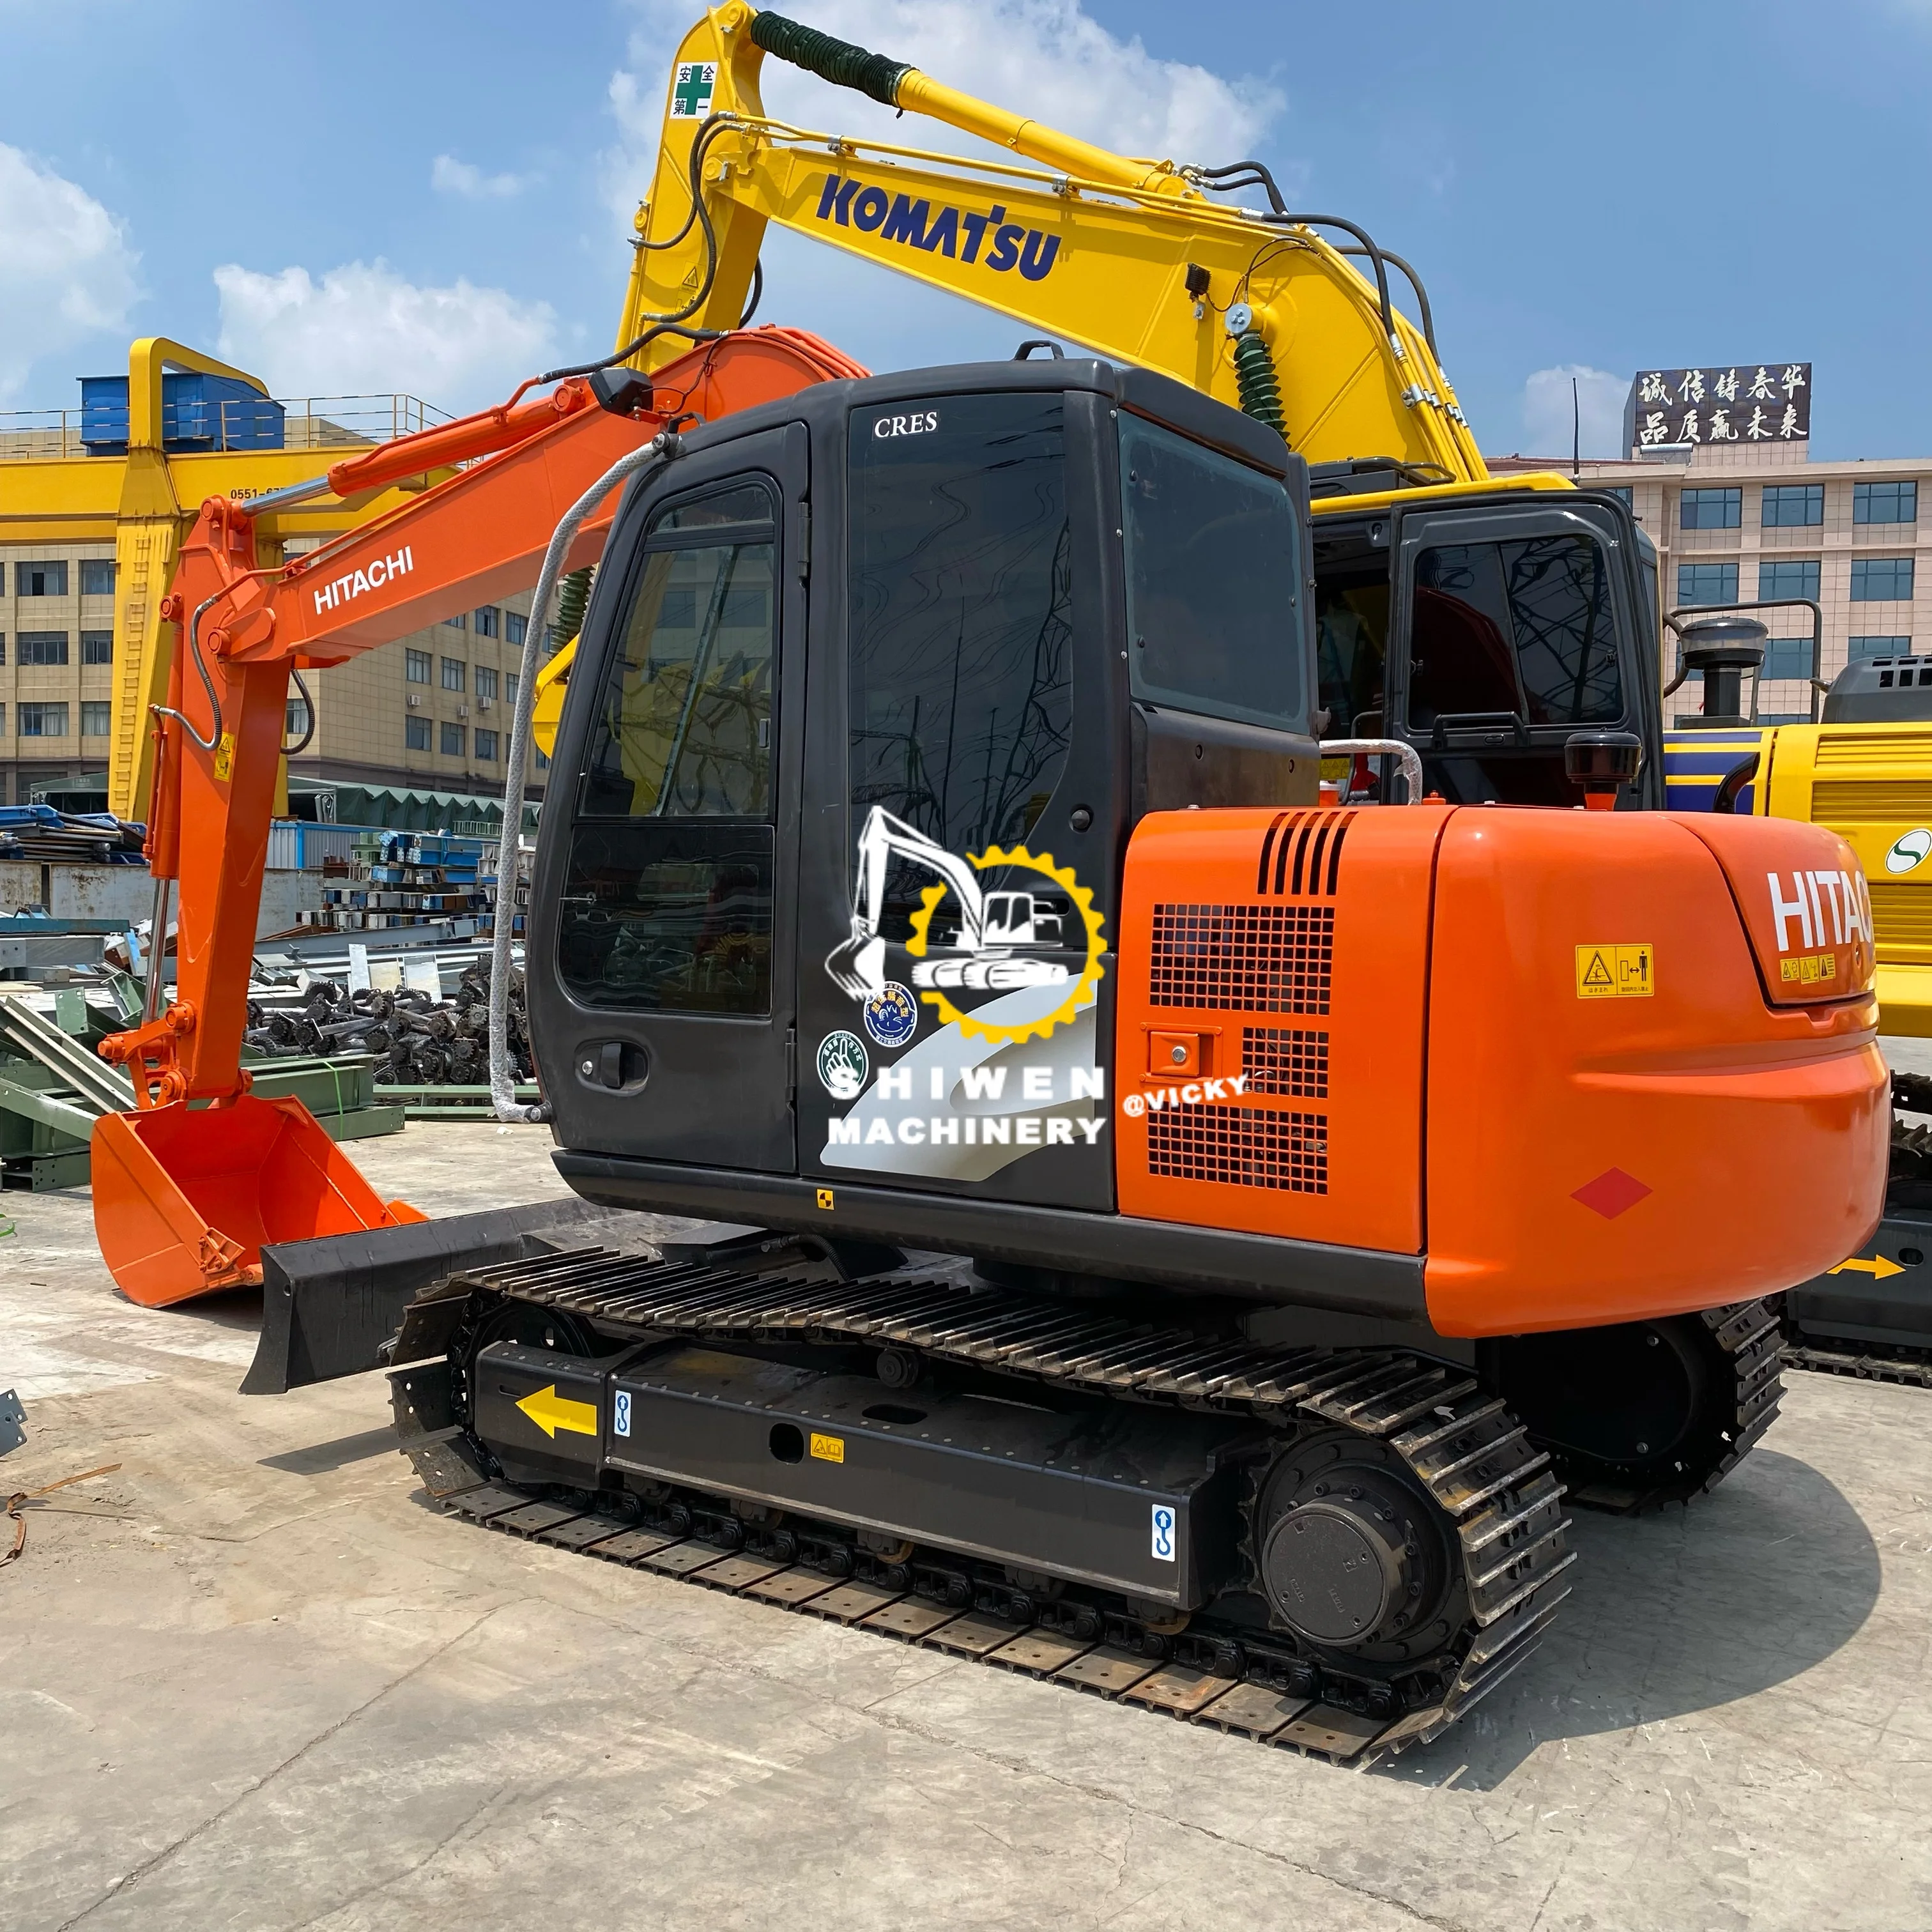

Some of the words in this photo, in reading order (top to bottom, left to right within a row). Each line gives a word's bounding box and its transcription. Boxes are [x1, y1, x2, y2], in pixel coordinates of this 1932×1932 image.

[679, 65, 714, 82] 安全
[673, 99, 708, 114] 第一
[816, 174, 1061, 281] KOMATSU
[1639, 364, 1806, 406] 诚信铸春华
[874, 411, 937, 438] CRES
[1640, 403, 1807, 444] 品质赢未来
[231, 487, 286, 499] 0551-6
[313, 546, 414, 615] HITACHI
